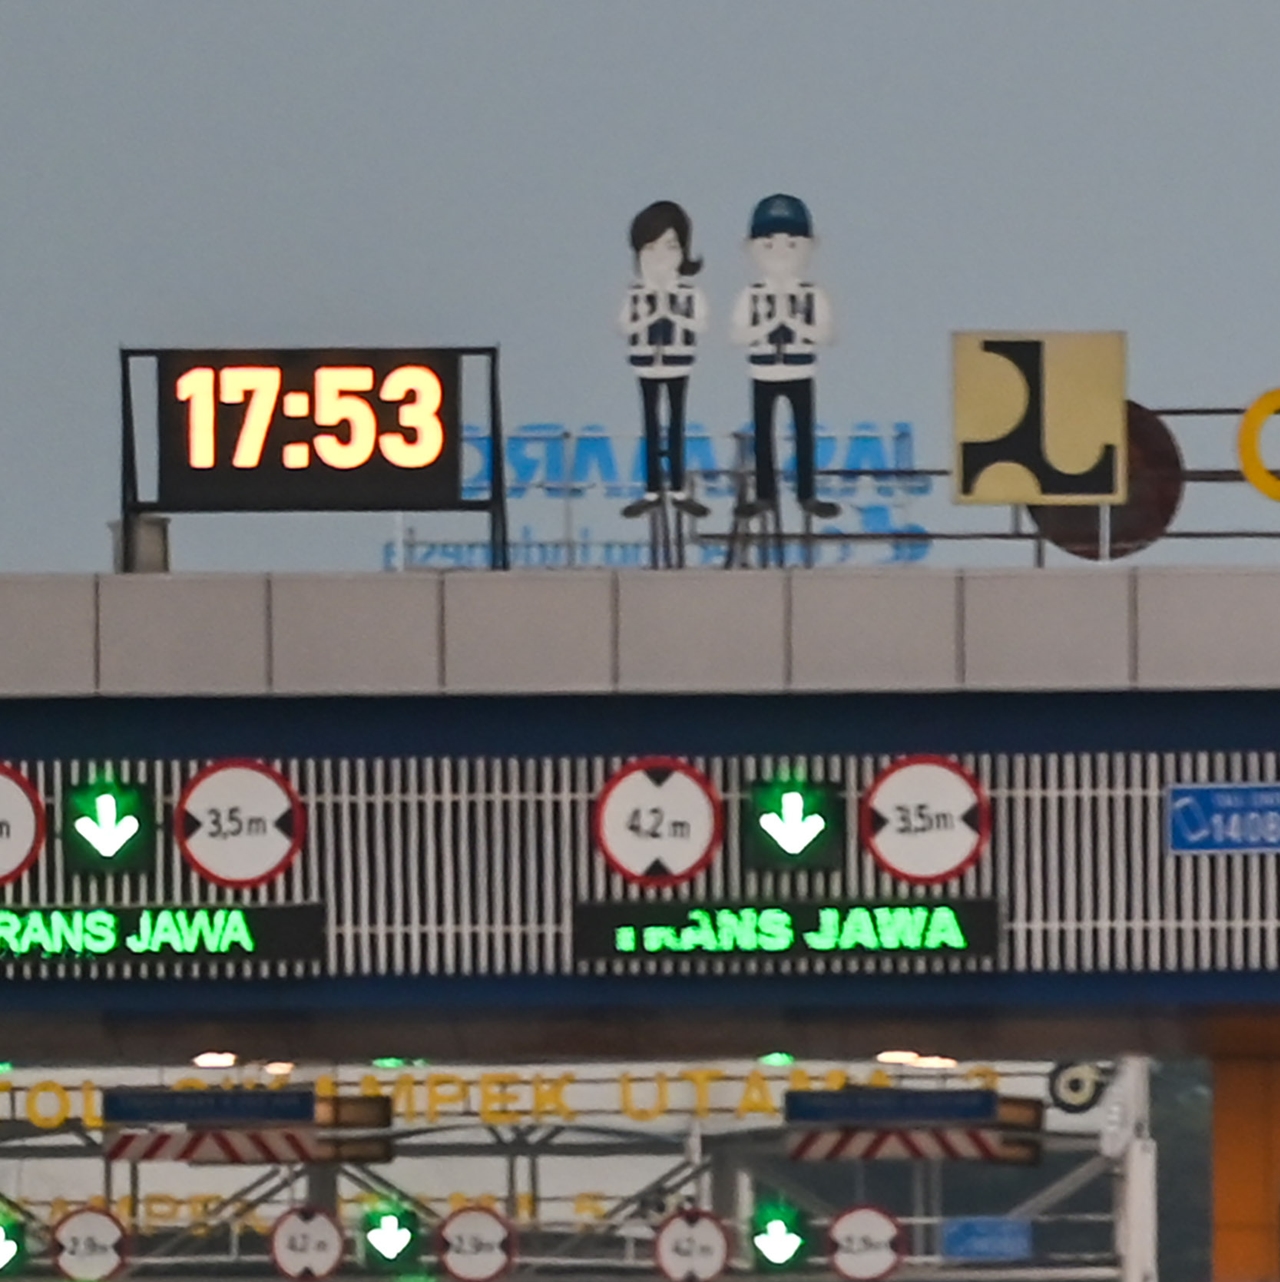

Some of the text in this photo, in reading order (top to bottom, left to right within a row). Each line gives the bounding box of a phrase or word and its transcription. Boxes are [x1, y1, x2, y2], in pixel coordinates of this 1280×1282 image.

[176, 365, 445, 470] 17:53
[126, 909, 255, 953] JAWA
[803, 906, 969, 950] JAWA
